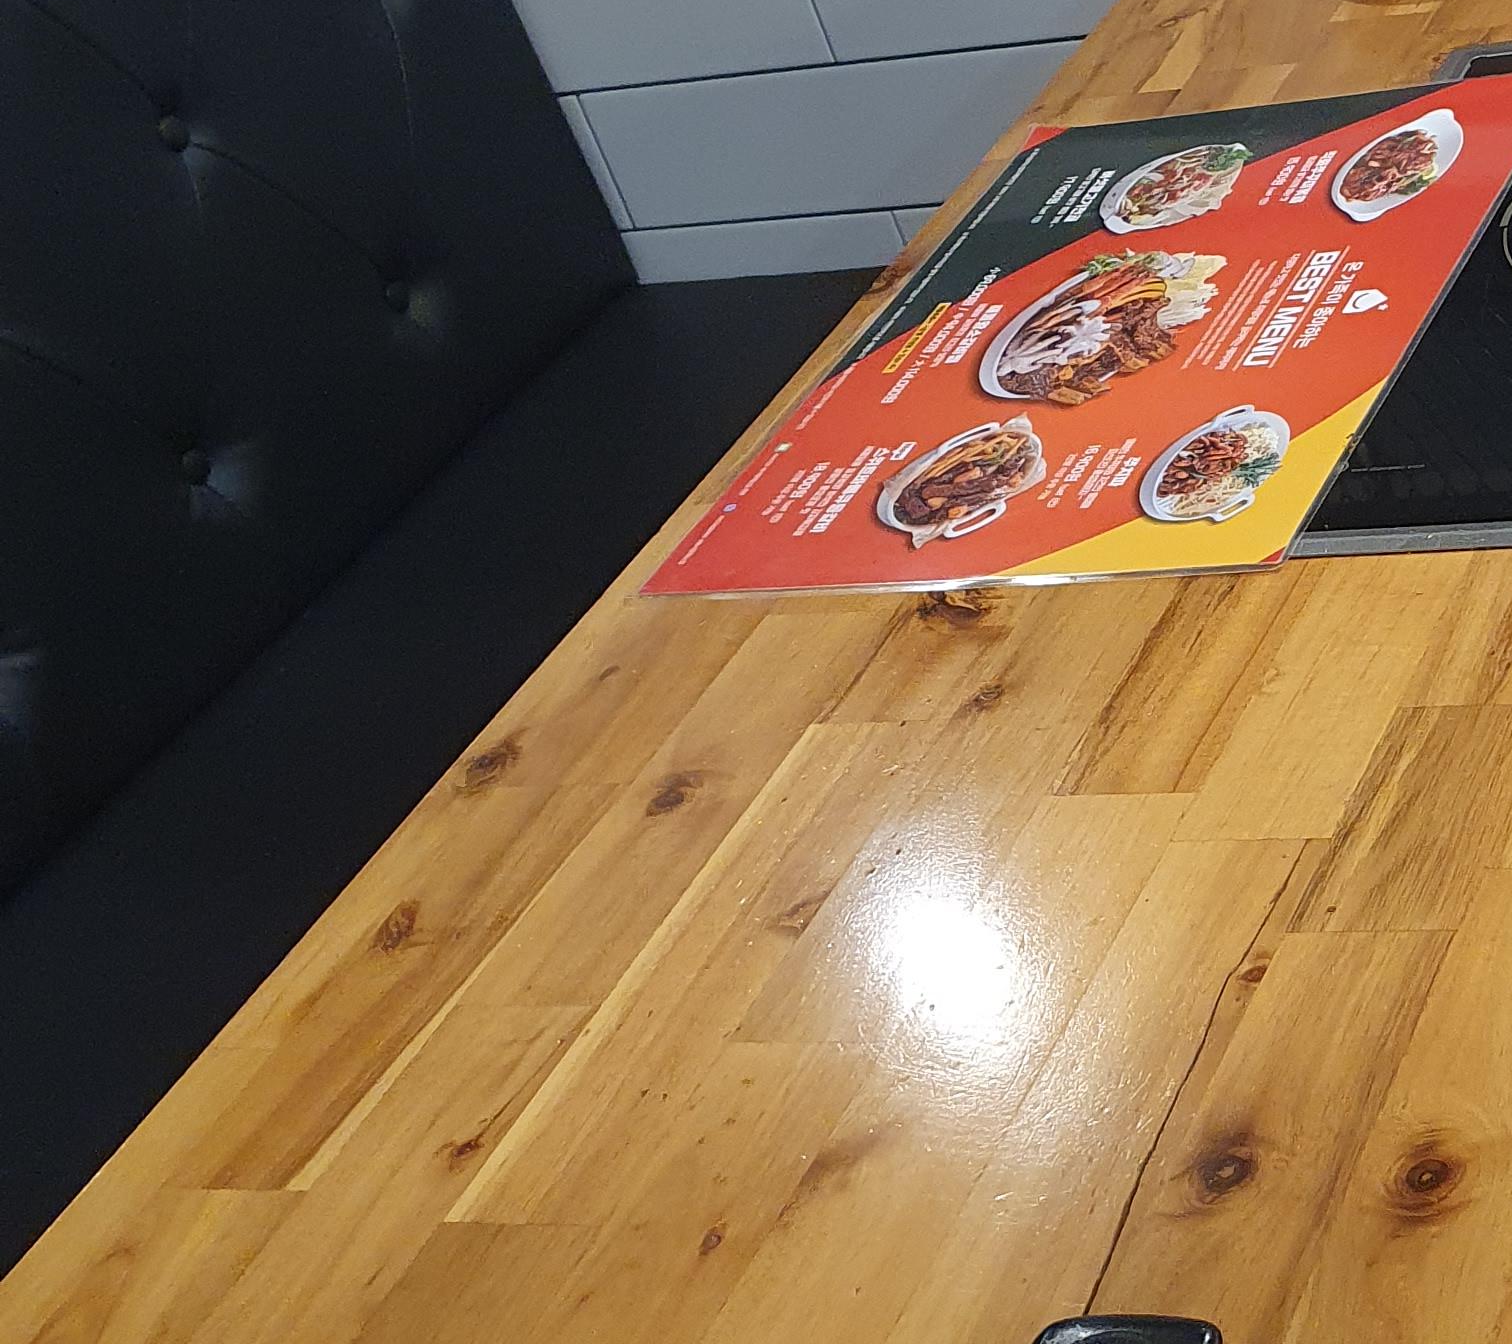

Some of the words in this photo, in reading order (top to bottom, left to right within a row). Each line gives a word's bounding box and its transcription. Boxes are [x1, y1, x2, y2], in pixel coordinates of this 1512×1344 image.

[1286, 250, 1340, 303] BEST
[1341, 261, 1363, 272] 온
[1320, 273, 1355, 304] 가족이
[1242, 305, 1304, 366] MENU
[1292, 306, 1335, 348] 좋아하는
